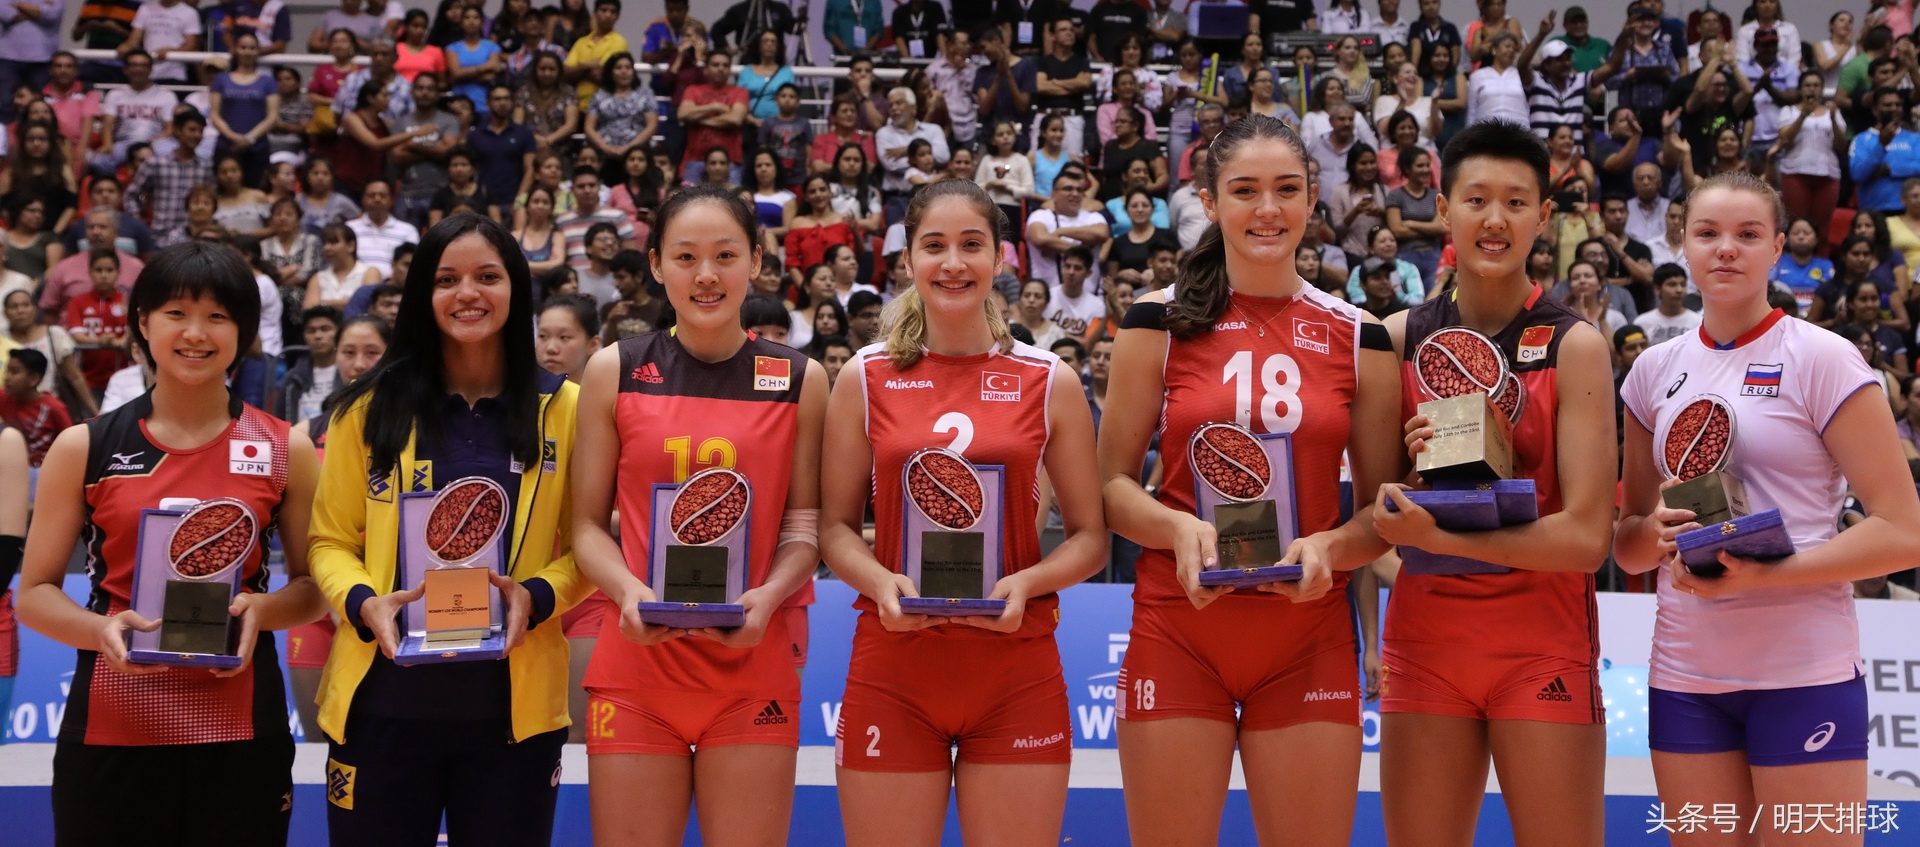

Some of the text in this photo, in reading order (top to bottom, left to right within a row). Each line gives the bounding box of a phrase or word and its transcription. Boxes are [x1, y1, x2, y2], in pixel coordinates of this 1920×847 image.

[631, 371, 664, 384] adidas
[758, 378, 786, 388] CHN
[1222, 350, 1303, 434] 18
[1746, 386, 1774, 395] RUS
[932, 411, 974, 456] 2
[236, 463, 264, 473] JPN
[1133, 678, 1155, 710] 18
[1536, 692, 1572, 702] adidas
[591, 701, 616, 738] 12
[754, 714, 788, 725] adidas
[866, 725, 881, 757] 2
